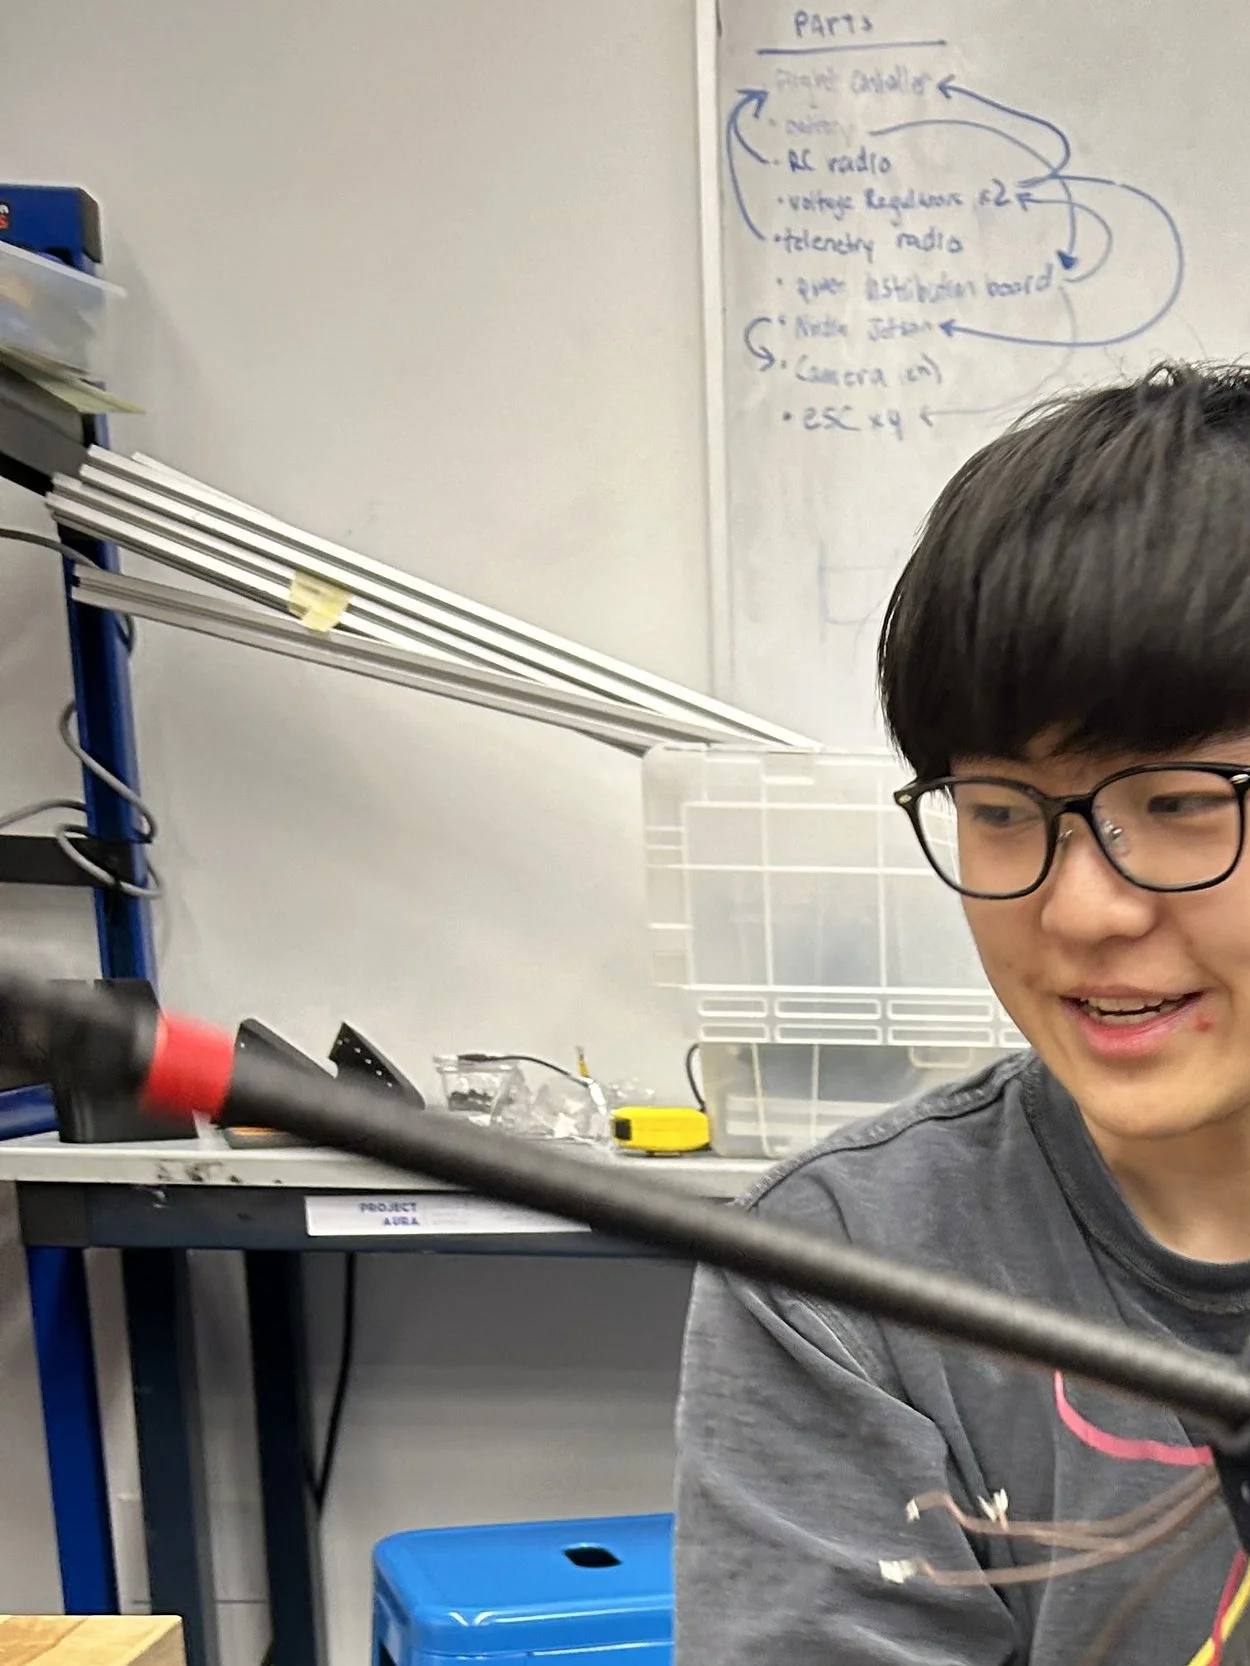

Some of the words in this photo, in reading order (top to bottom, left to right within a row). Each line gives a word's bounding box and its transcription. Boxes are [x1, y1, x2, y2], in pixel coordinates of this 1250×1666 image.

[828, 146, 892, 174] radio
[896, 225, 964, 253] radio
[358, 1201, 418, 1214] PROJECT
[383, 1215, 421, 1227] AURA
